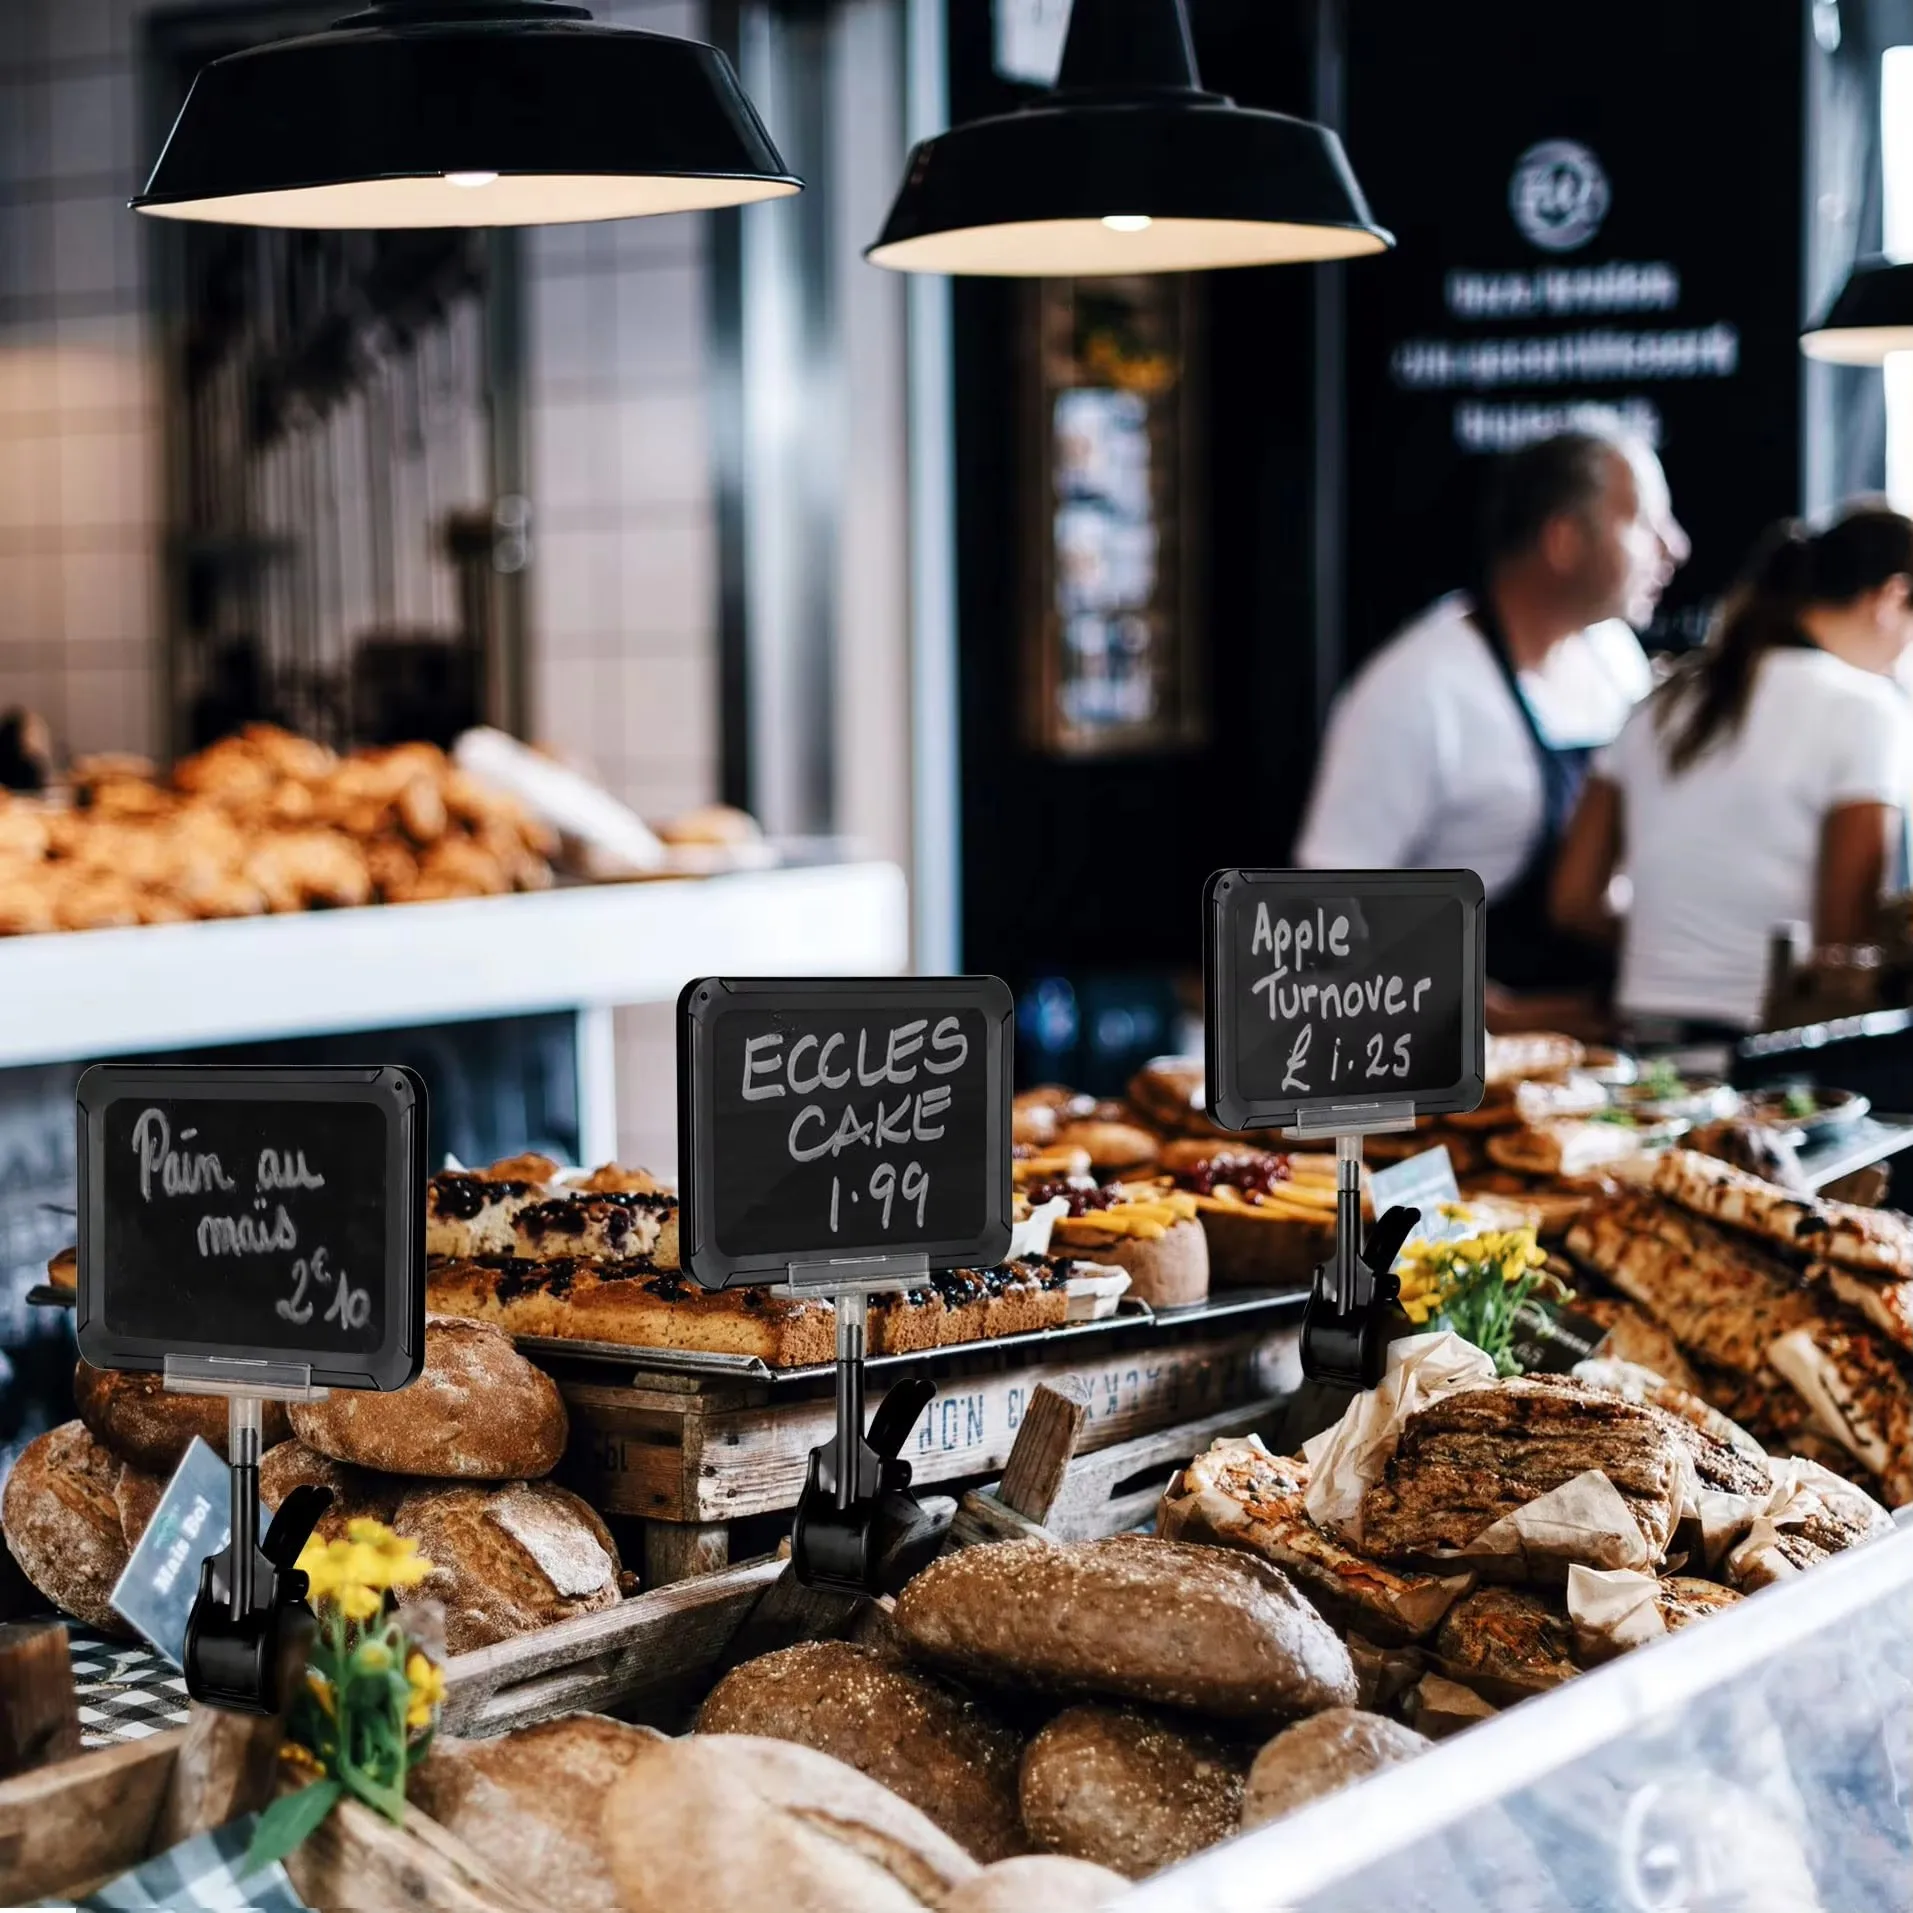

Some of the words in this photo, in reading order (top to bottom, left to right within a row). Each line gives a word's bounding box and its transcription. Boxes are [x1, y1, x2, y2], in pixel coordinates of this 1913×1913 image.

[1251, 901, 1350, 972] Apple
[1251, 965, 1432, 1021] Turnover
[741, 1016, 968, 1101] ECCLES
[132, 1107, 235, 1202] Pain
[257, 1148, 325, 1191] au
[788, 1084, 952, 1162] CAKE
[829, 1161, 929, 1233] 1.99
